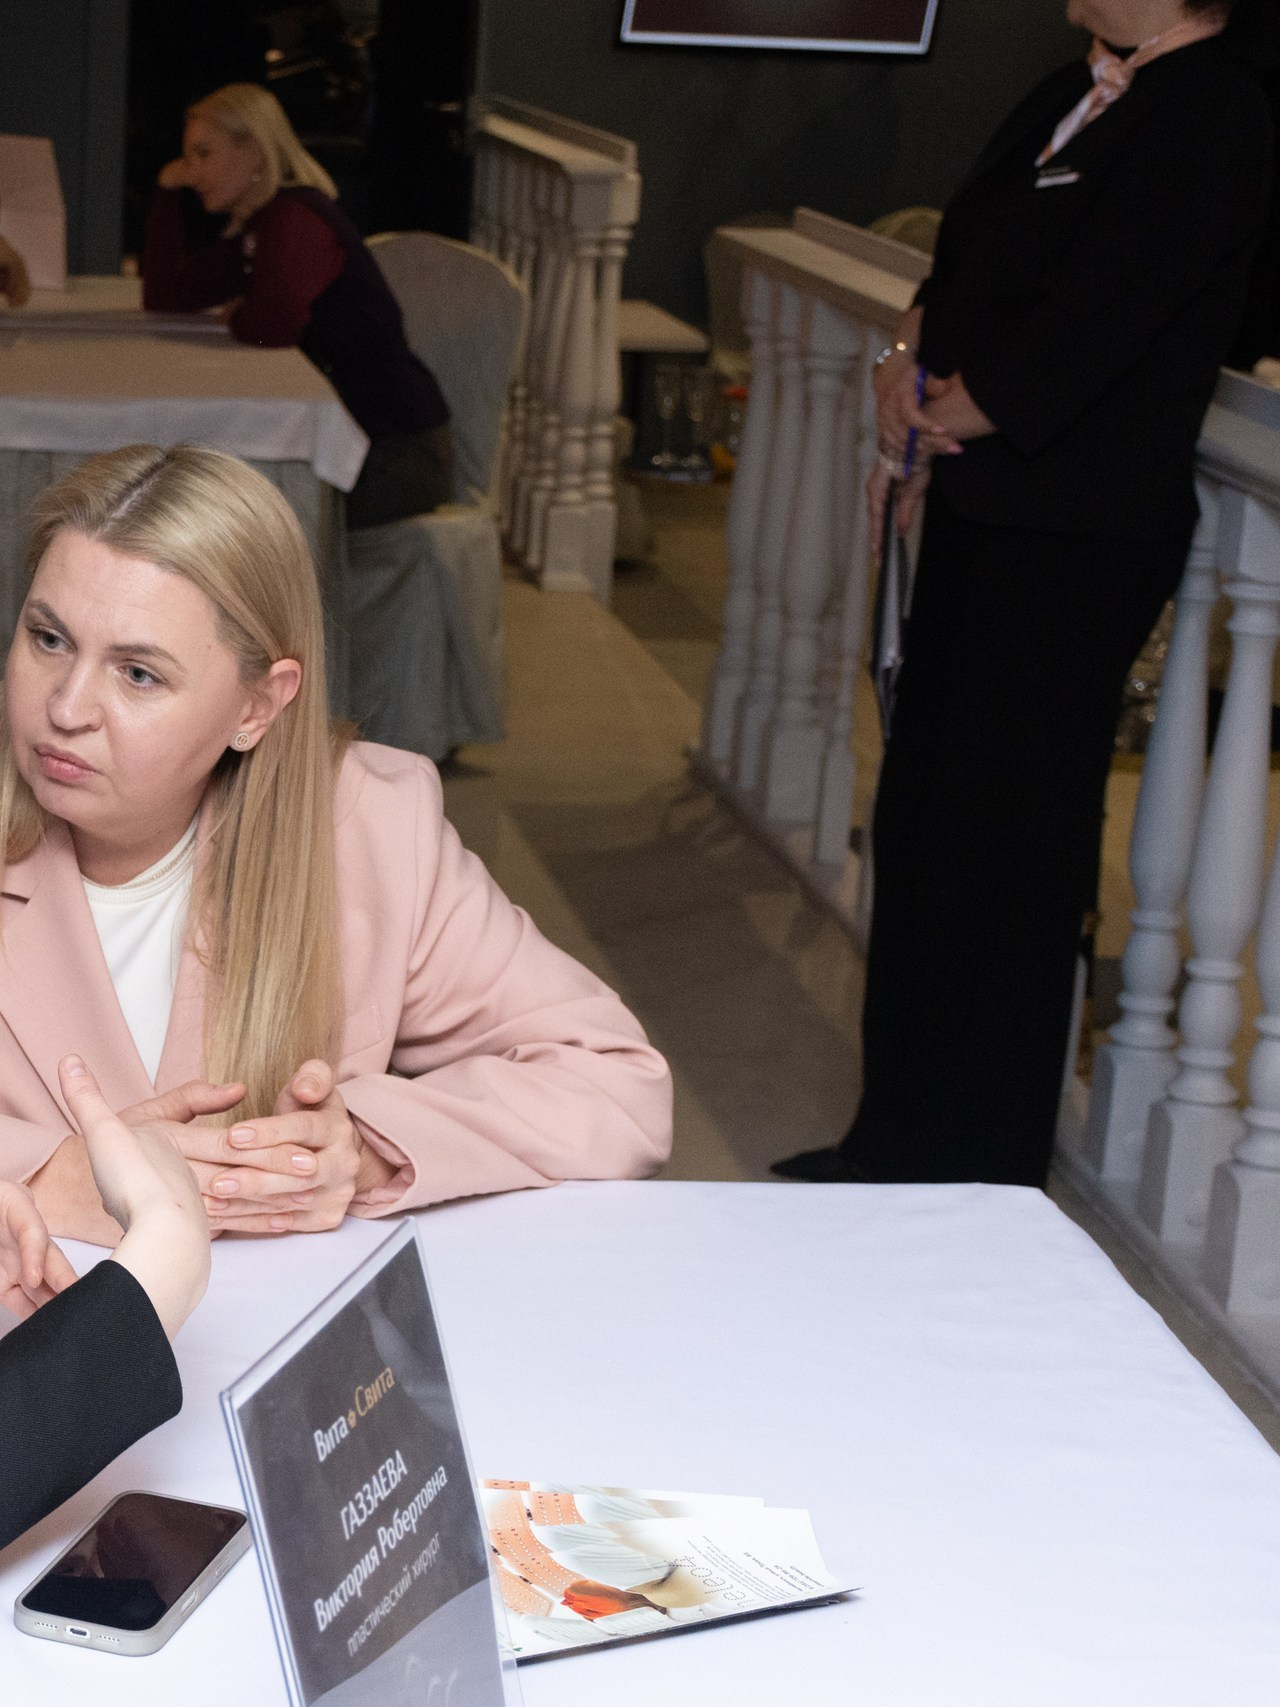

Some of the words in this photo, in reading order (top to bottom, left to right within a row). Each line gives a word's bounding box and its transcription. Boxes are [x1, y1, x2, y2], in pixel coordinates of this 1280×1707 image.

[313, 1415, 349, 1462] Вита
[355, 1367, 395, 1416] Свита
[313, 1545, 381, 1634] Виктория
[377, 1465, 449, 1559] Робертовна
[340, 1449, 408, 1541] ГАЗЗАЕВА
[347, 1563, 414, 1657] пластический
[410, 1531, 442, 1577] хирург
